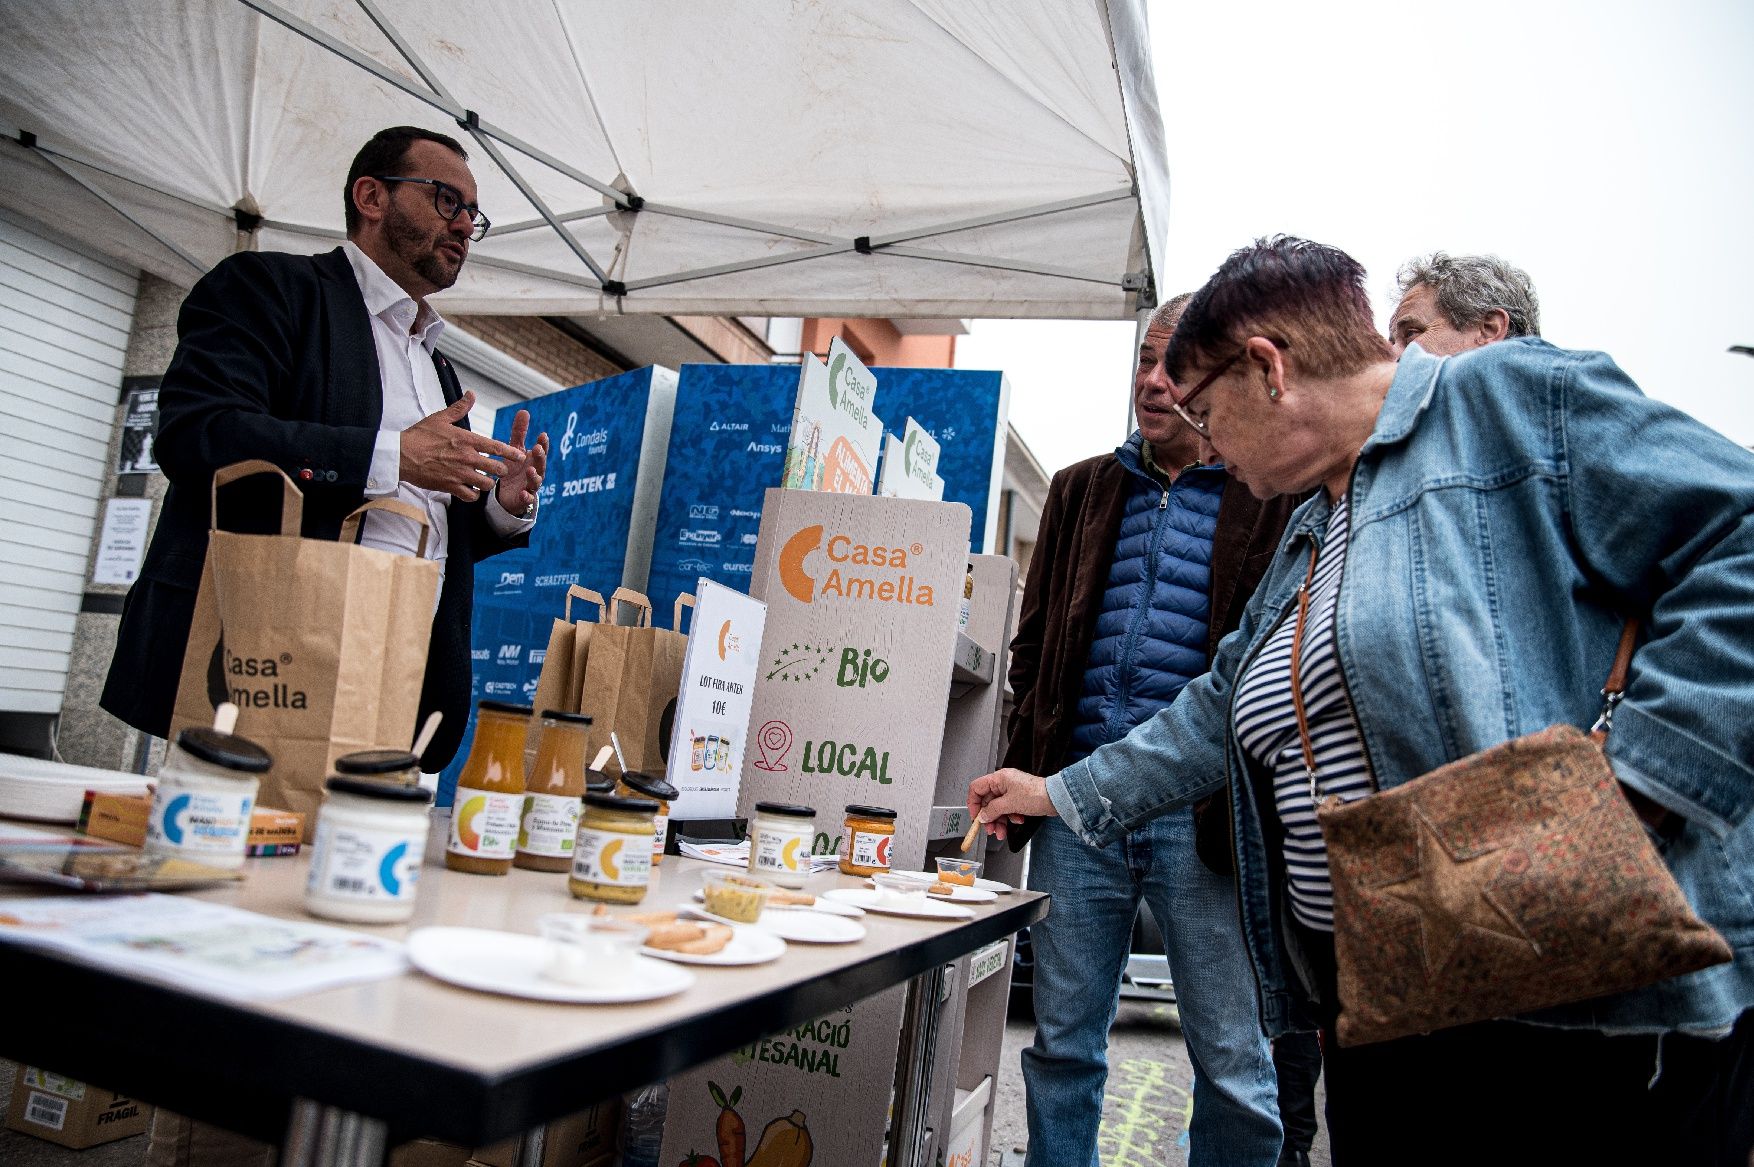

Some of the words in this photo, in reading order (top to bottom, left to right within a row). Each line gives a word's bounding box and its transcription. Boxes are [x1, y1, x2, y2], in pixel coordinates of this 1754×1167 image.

[839, 389, 868, 431] Amella
[721, 423, 749, 431] ALTAIR
[576, 428, 608, 448] Condals
[747, 441, 782, 454] Ansys
[562, 475, 605, 497] ZOLTEK
[911, 461, 934, 490] Amella
[534, 573, 579, 587] SCHAEFFLER
[821, 569, 934, 606] Amella
[836, 647, 890, 688] Bio
[700, 675, 712, 688] LOT
[229, 682, 307, 709] mella
[712, 700, 726, 716] 10€
[801, 740, 893, 785] LOCAL
[98, 1104, 139, 1125] FRAGIL
